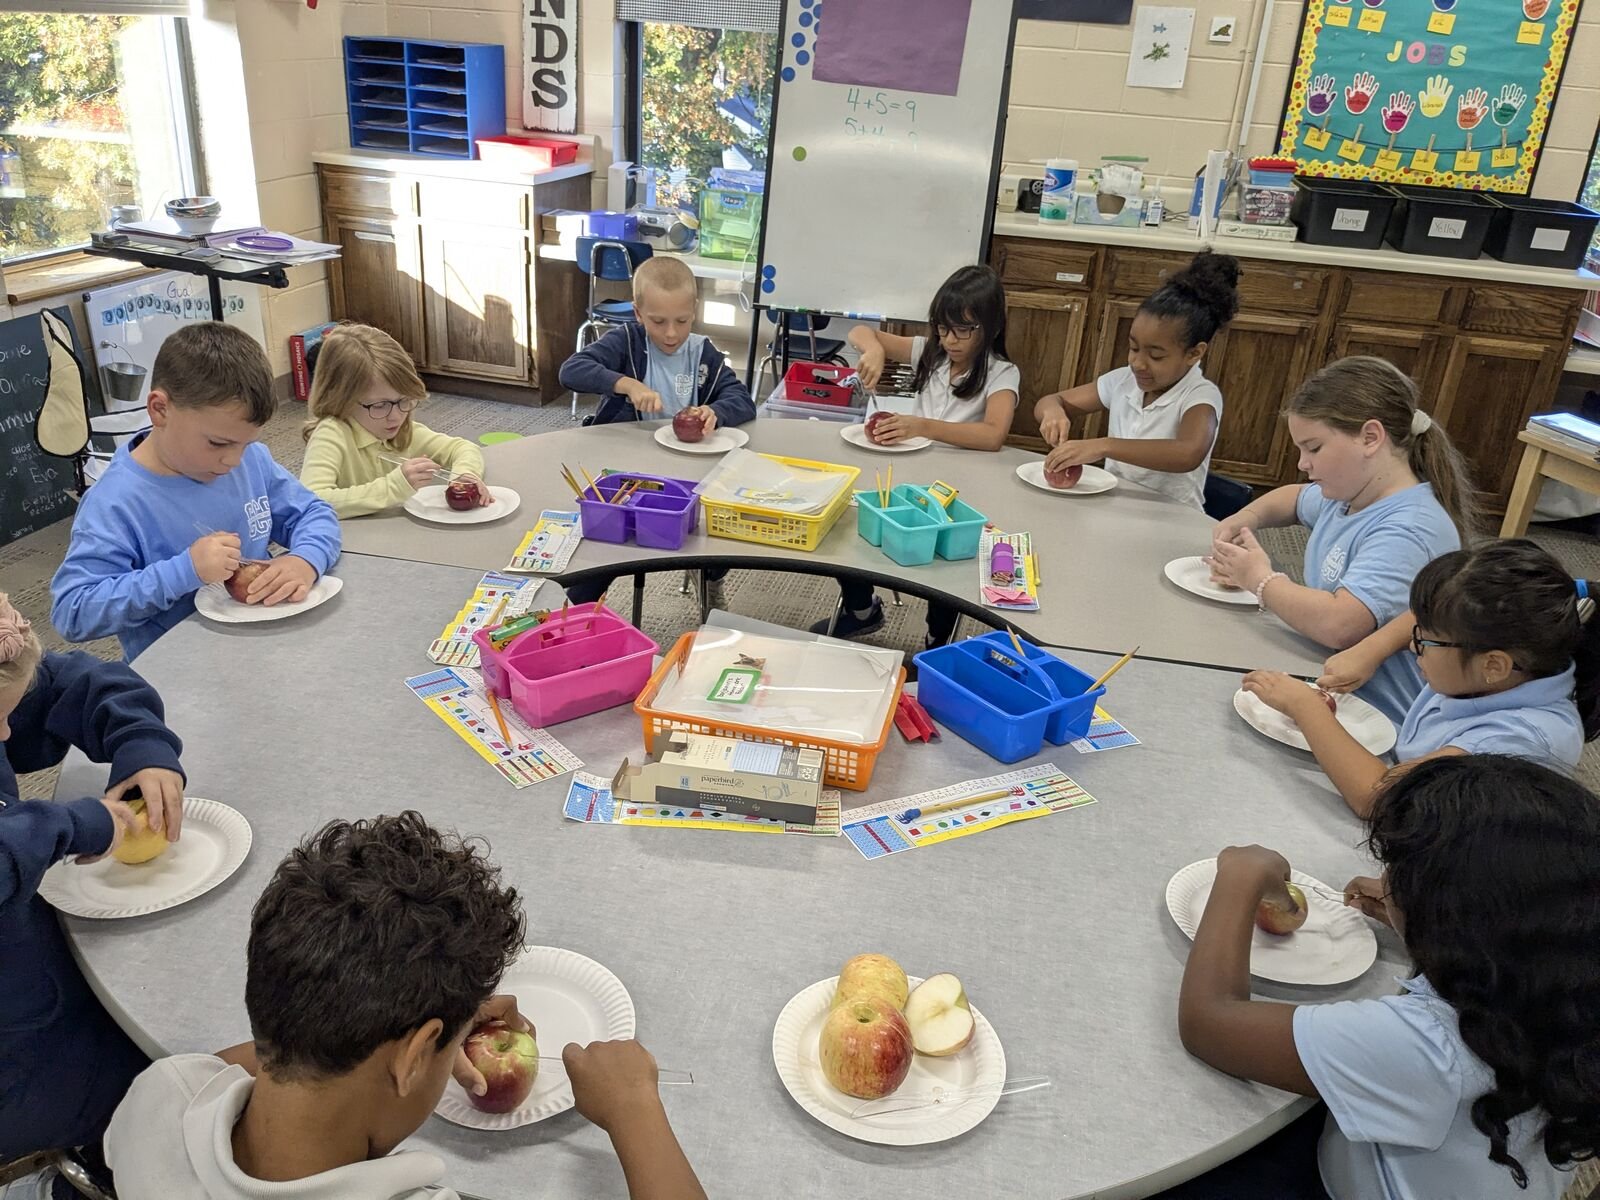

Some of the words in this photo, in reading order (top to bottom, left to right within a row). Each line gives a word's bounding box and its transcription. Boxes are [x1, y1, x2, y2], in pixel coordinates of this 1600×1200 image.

[1386, 40, 1467, 67] JOBS
[846, 87, 918, 123] 4+5=9
[1336, 210, 1361, 229] Orange
[1434, 219, 1460, 237] Yellow
[298, 370, 306, 397] COUNTING
[29, 467, 59, 484] Eva
[701, 775, 735, 786] paperbird
